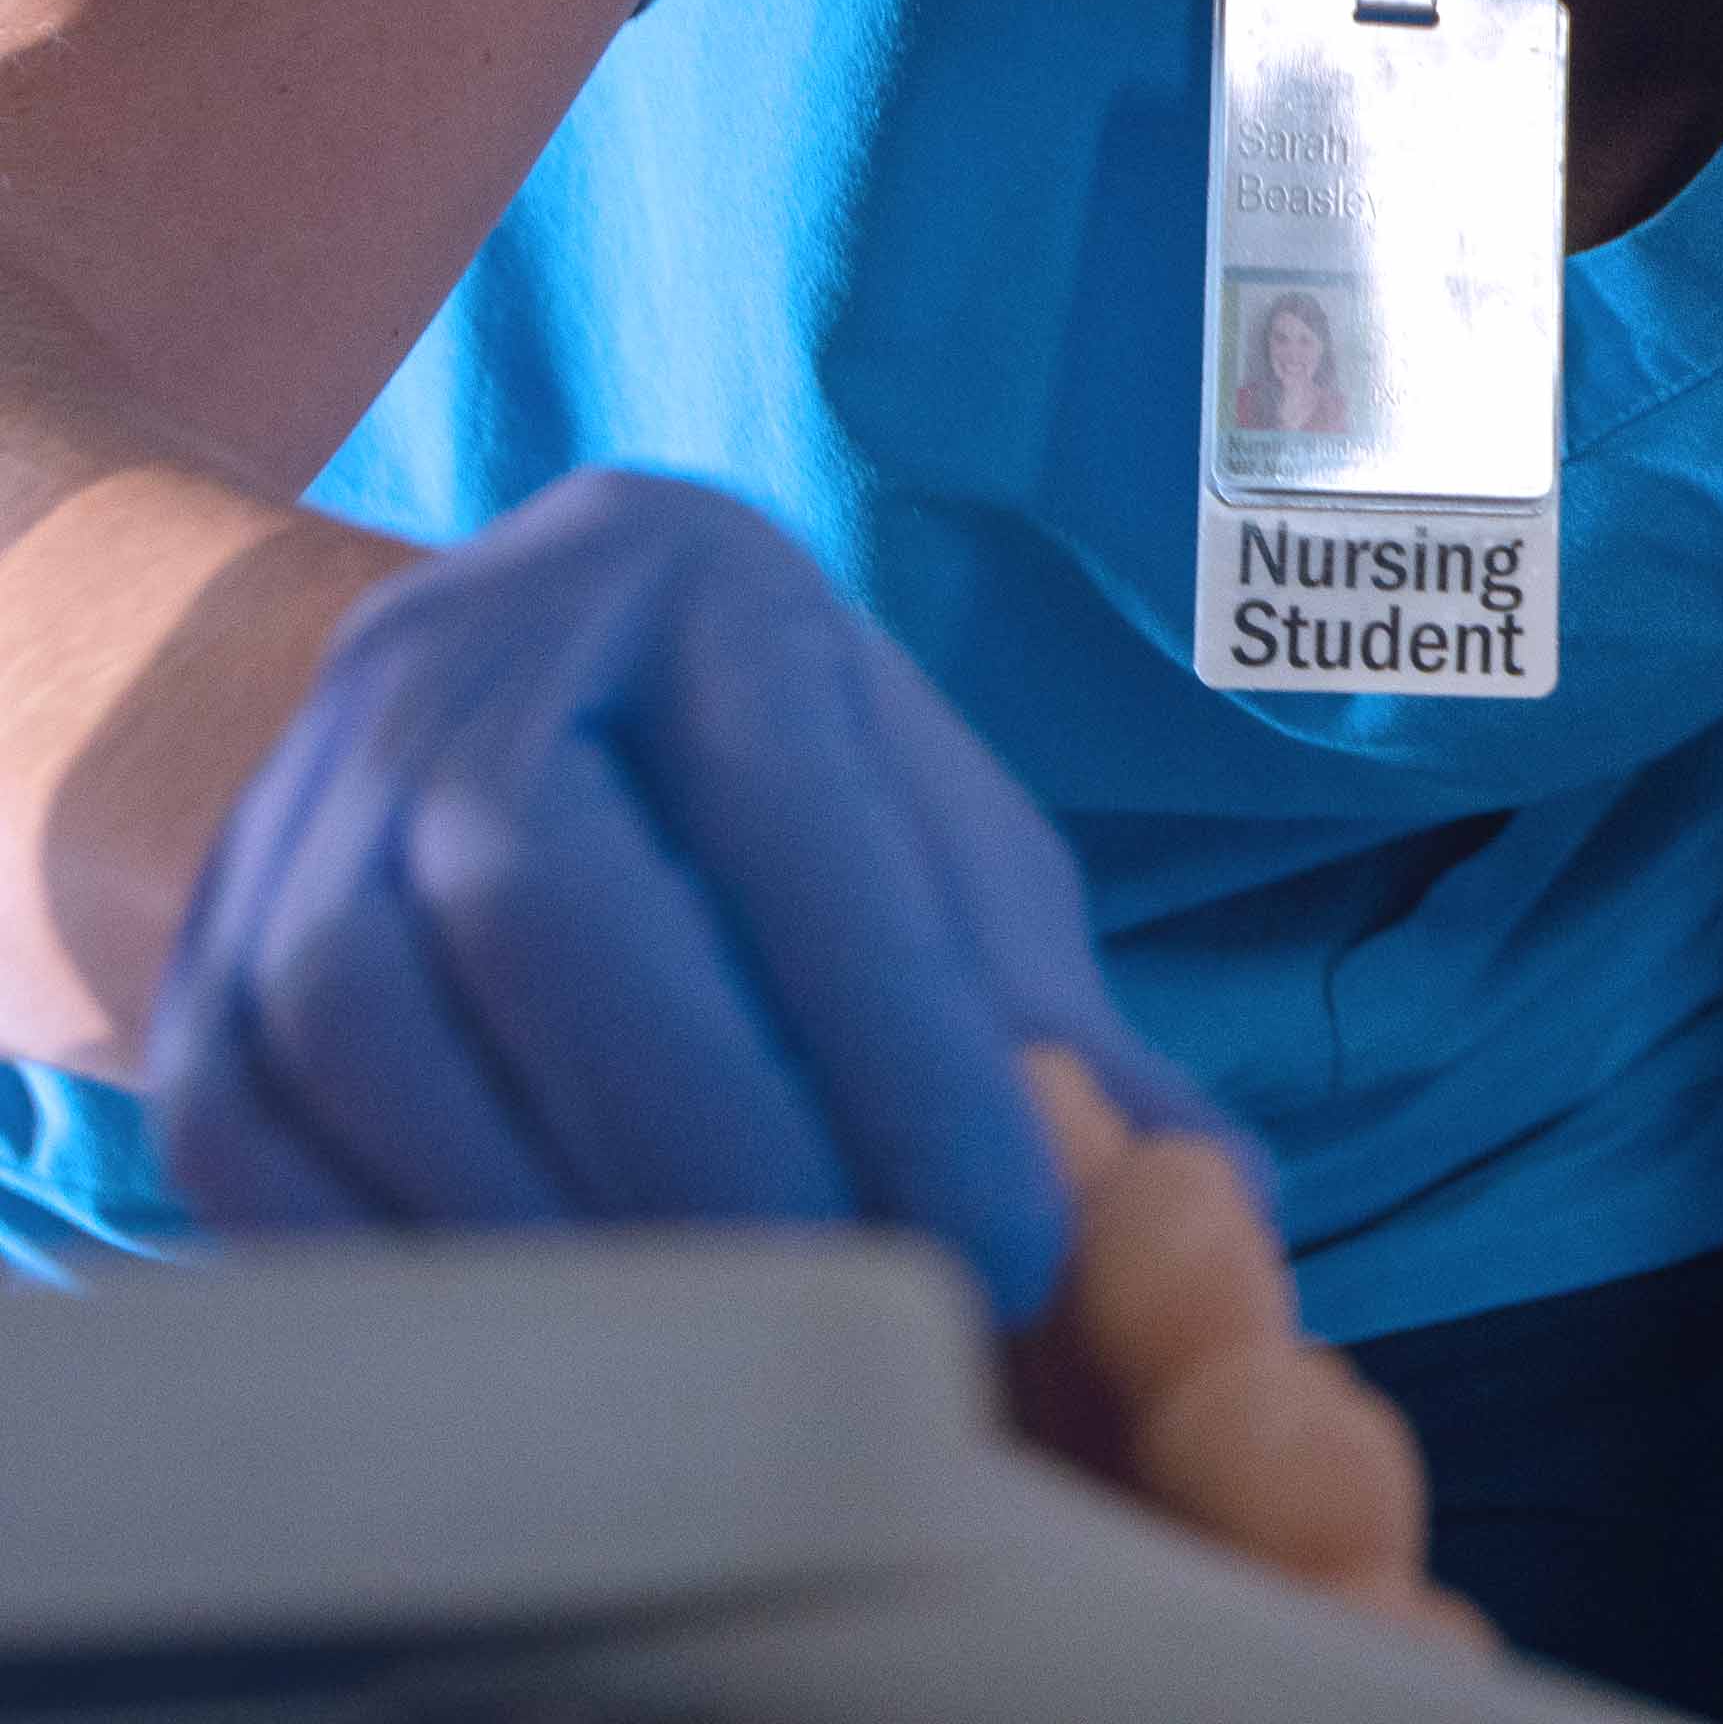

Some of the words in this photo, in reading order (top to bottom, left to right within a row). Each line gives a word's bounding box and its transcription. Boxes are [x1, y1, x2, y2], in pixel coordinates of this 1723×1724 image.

[1238, 120, 1352, 165] Sarah
[1237, 173, 1381, 224] Beasley
[1238, 520, 1525, 612] Nursing
[1230, 598, 1526, 677] Student
